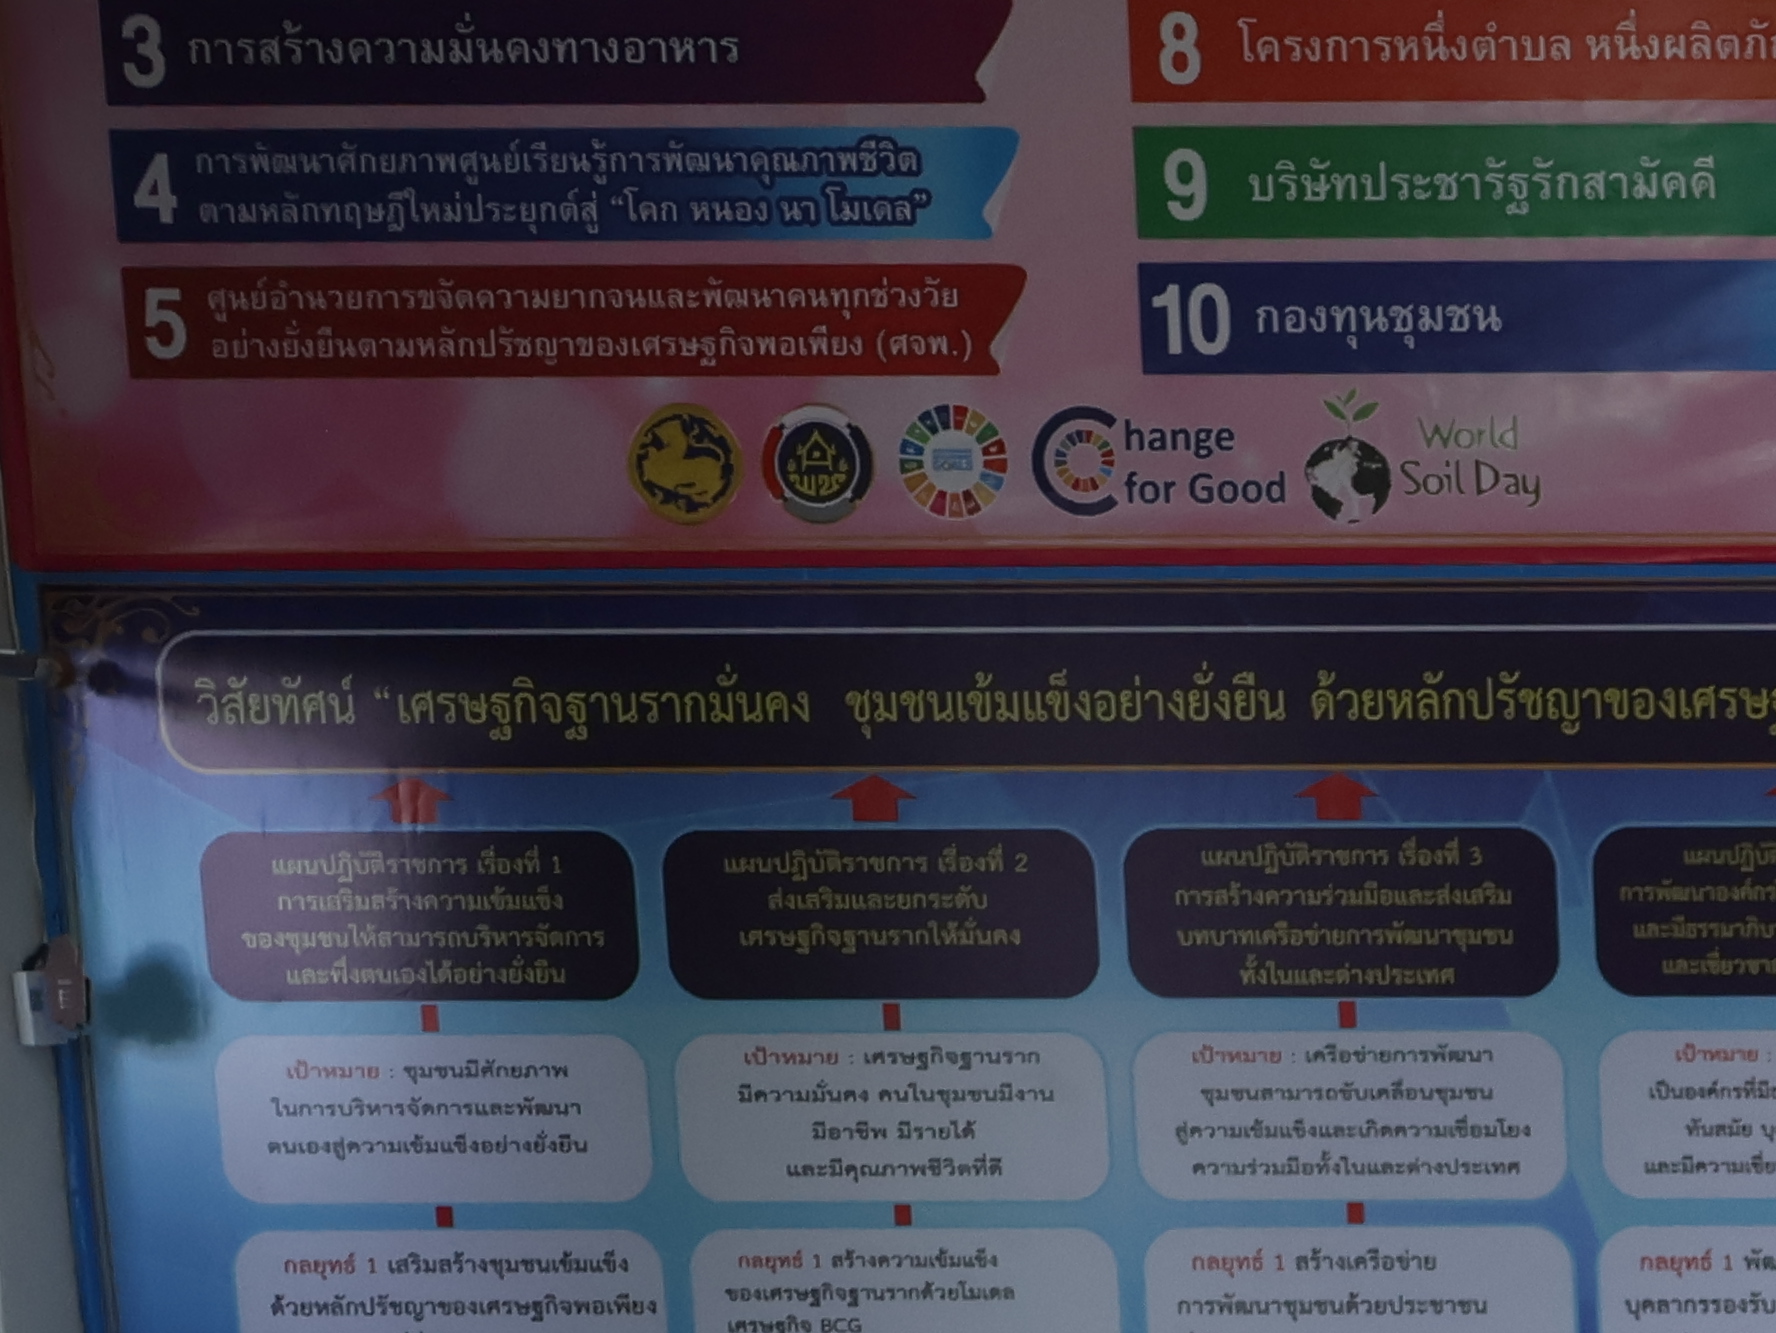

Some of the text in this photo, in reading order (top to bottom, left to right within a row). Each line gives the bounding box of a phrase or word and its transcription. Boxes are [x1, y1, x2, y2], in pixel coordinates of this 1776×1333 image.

[121, 14, 166, 89] 3
[187, 12, 739, 65] การสร้างความมั่นคงทางอาหาร
[1158, 11, 1202, 84] 8
[1237, 8, 1571, 65] โครงการหนึ่งตำบล
[194, 137, 918, 186] การพัฒนาศักยภาพศูนย์เรียนรู้การพัฒนาคุณภาพชีวิต
[1164, 148, 1208, 221] 9
[1248, 155, 1717, 215] บริษัทประชารัฐรักสามัคคี
[133, 153, 178, 224] 4
[200, 188, 599, 234] ตามหลักทฤษฎีใหม่ประยุกต์สู่
[691, 196, 768, 223] หนอง
[780, 196, 816, 223] นา
[144, 289, 187, 360] 5
[207, 276, 959, 326] ศูนย์อำนวยการขจัดความยากจนและพัฒนาคนทุกช่วงวัย
[1151, 283, 1231, 355] 10
[1255, 298, 1503, 349] กองทุนชุมชน
[211, 325, 863, 367] อย่างยั่งยืนตามหลักปรัชญาของเศรษฐกิจพอเพียง
[1417, 415, 1518, 450] World
[1124, 472, 1286, 503] for Good
[1400, 458, 1541, 507] Soil Day
[193, 675, 355, 727] วิสัยทัศน์
[374, 664, 810, 741] “เศรษฐกิจฐานรากมั่นคง
[843, 661, 1286, 739] ชุมชนเข้มแข็งอย่างยั่งยืน
[551, 854, 563, 875] 1
[1014, 853, 1028, 872] 2
[1469, 846, 1483, 866] 3
[368, 1259, 377, 1273] 1
[813, 1255, 822, 1268] 1
[1276, 1255, 1285, 1271] 1
[1723, 1255, 1732, 1271] 1
[821, 1318, 863, 1333] BCG
